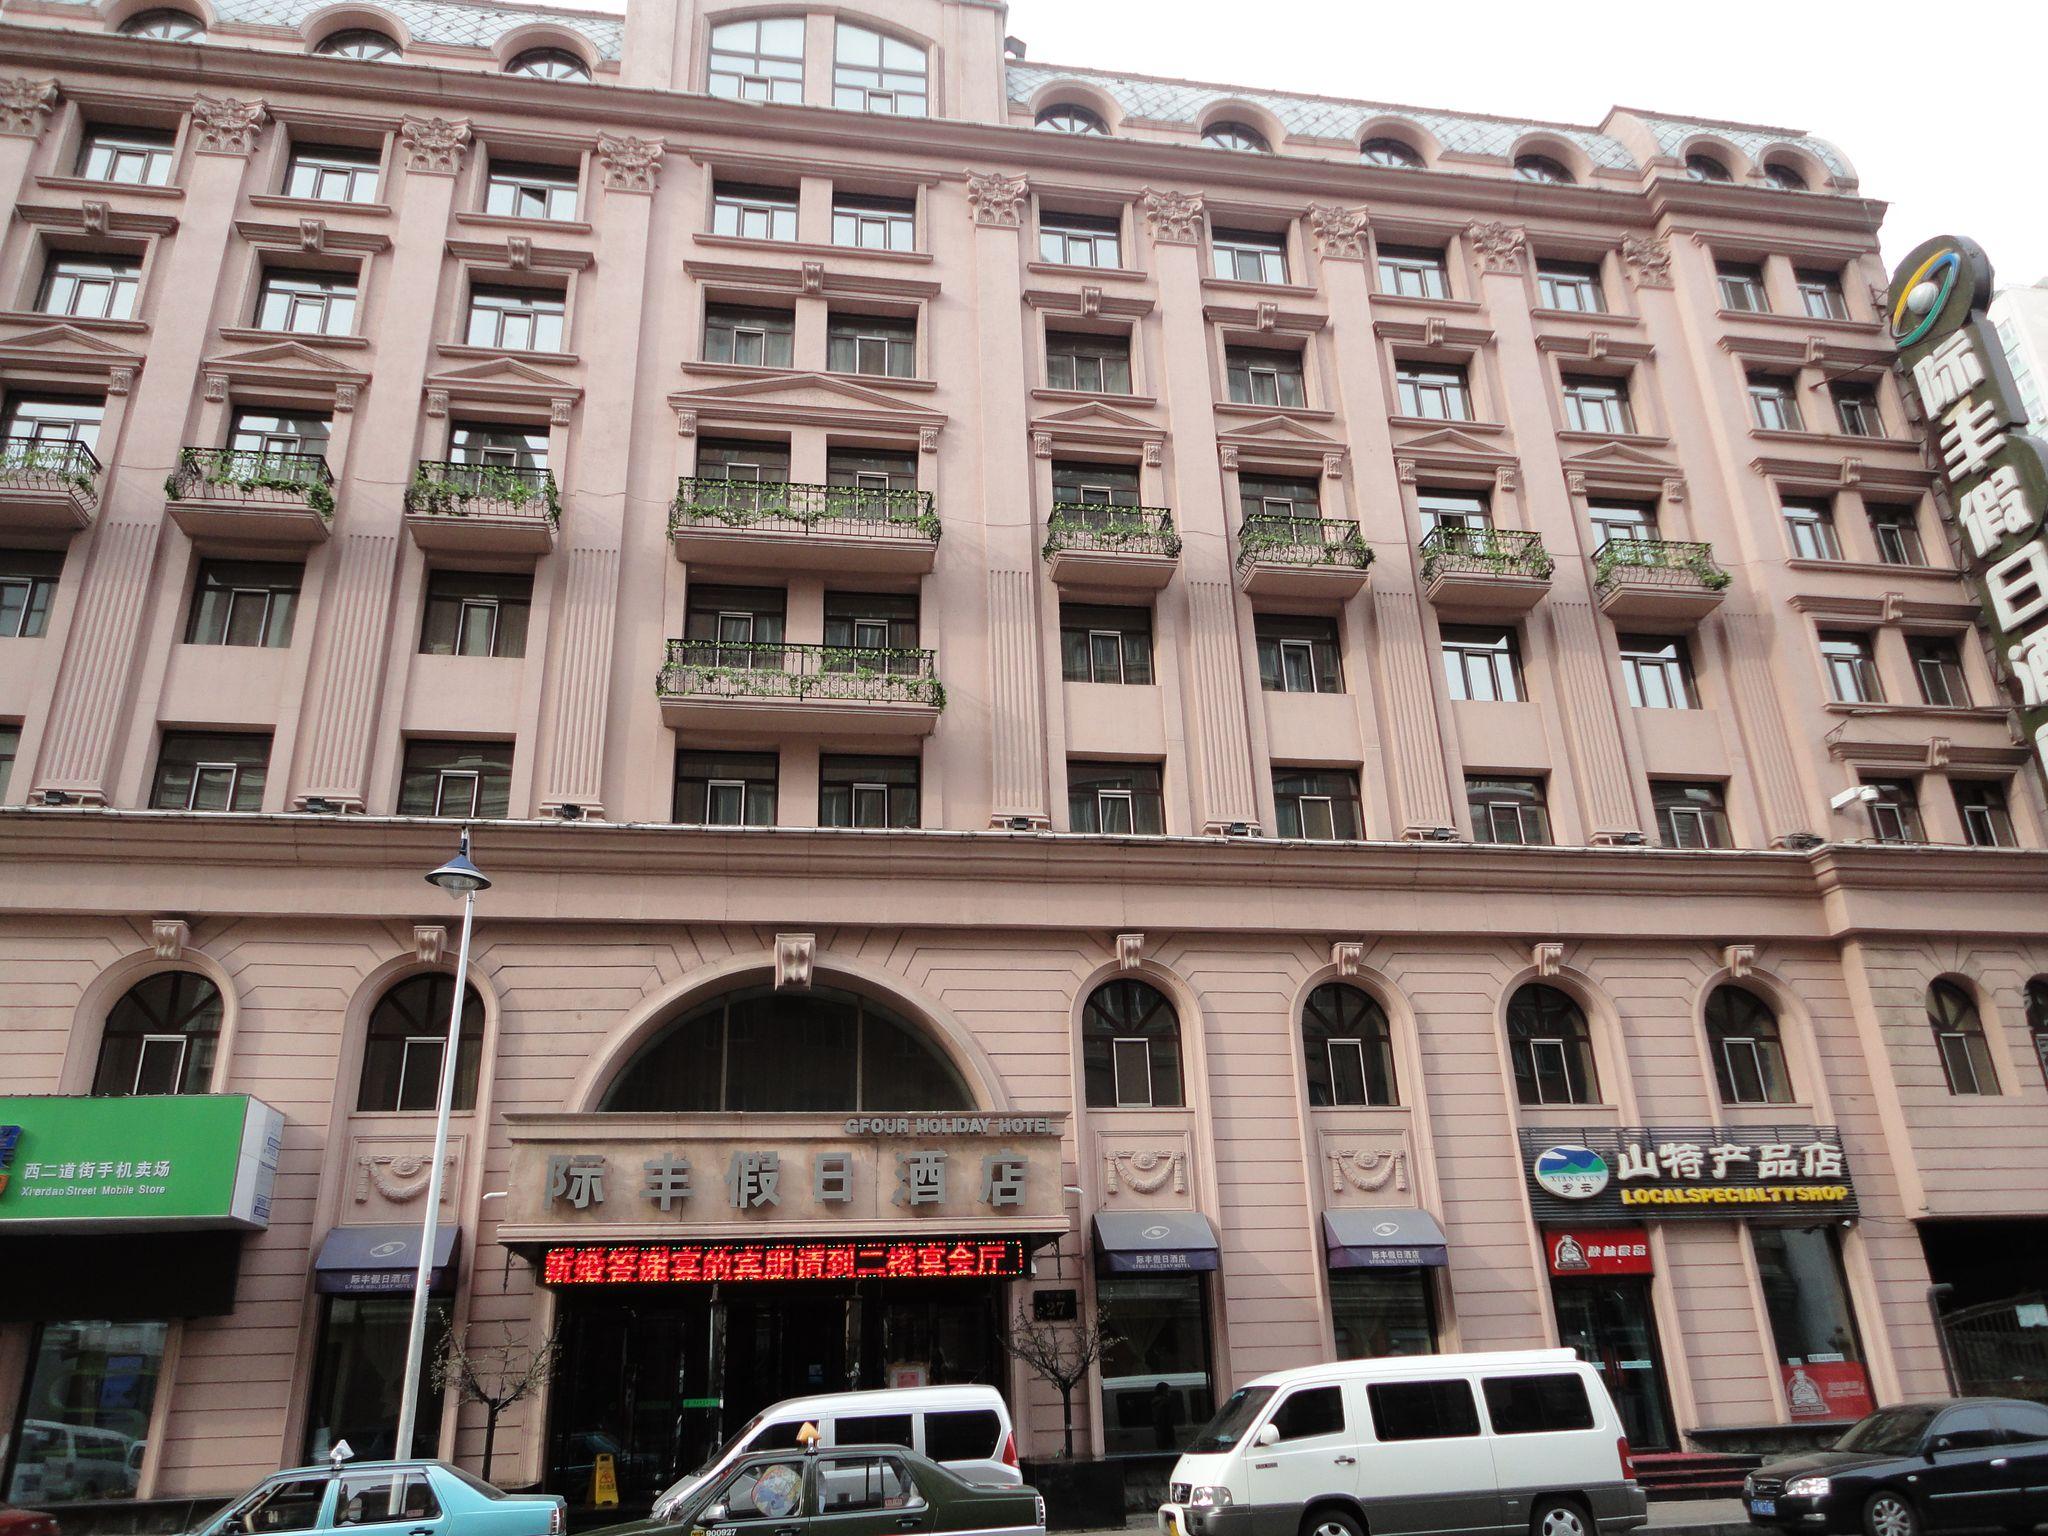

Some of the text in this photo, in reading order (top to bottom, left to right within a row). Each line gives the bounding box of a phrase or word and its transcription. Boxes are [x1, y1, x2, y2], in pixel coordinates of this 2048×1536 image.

[1913, 328, 2048, 770] 际丰假日酒
[845, 1117, 1056, 1134] GFOUR HOLIDAY HOTEL
[24, 1161, 170, 1180] 西二道街手机卖场
[1617, 1142, 1844, 1181] 山特产品店
[66, 1185, 97, 1196] Street
[101, 1185, 134, 1196] Mobile
[138, 1184, 166, 1195] Store
[543, 1149, 1029, 1212] 际丰假日酒店
[705, 1527, 737, 1536] 900927
